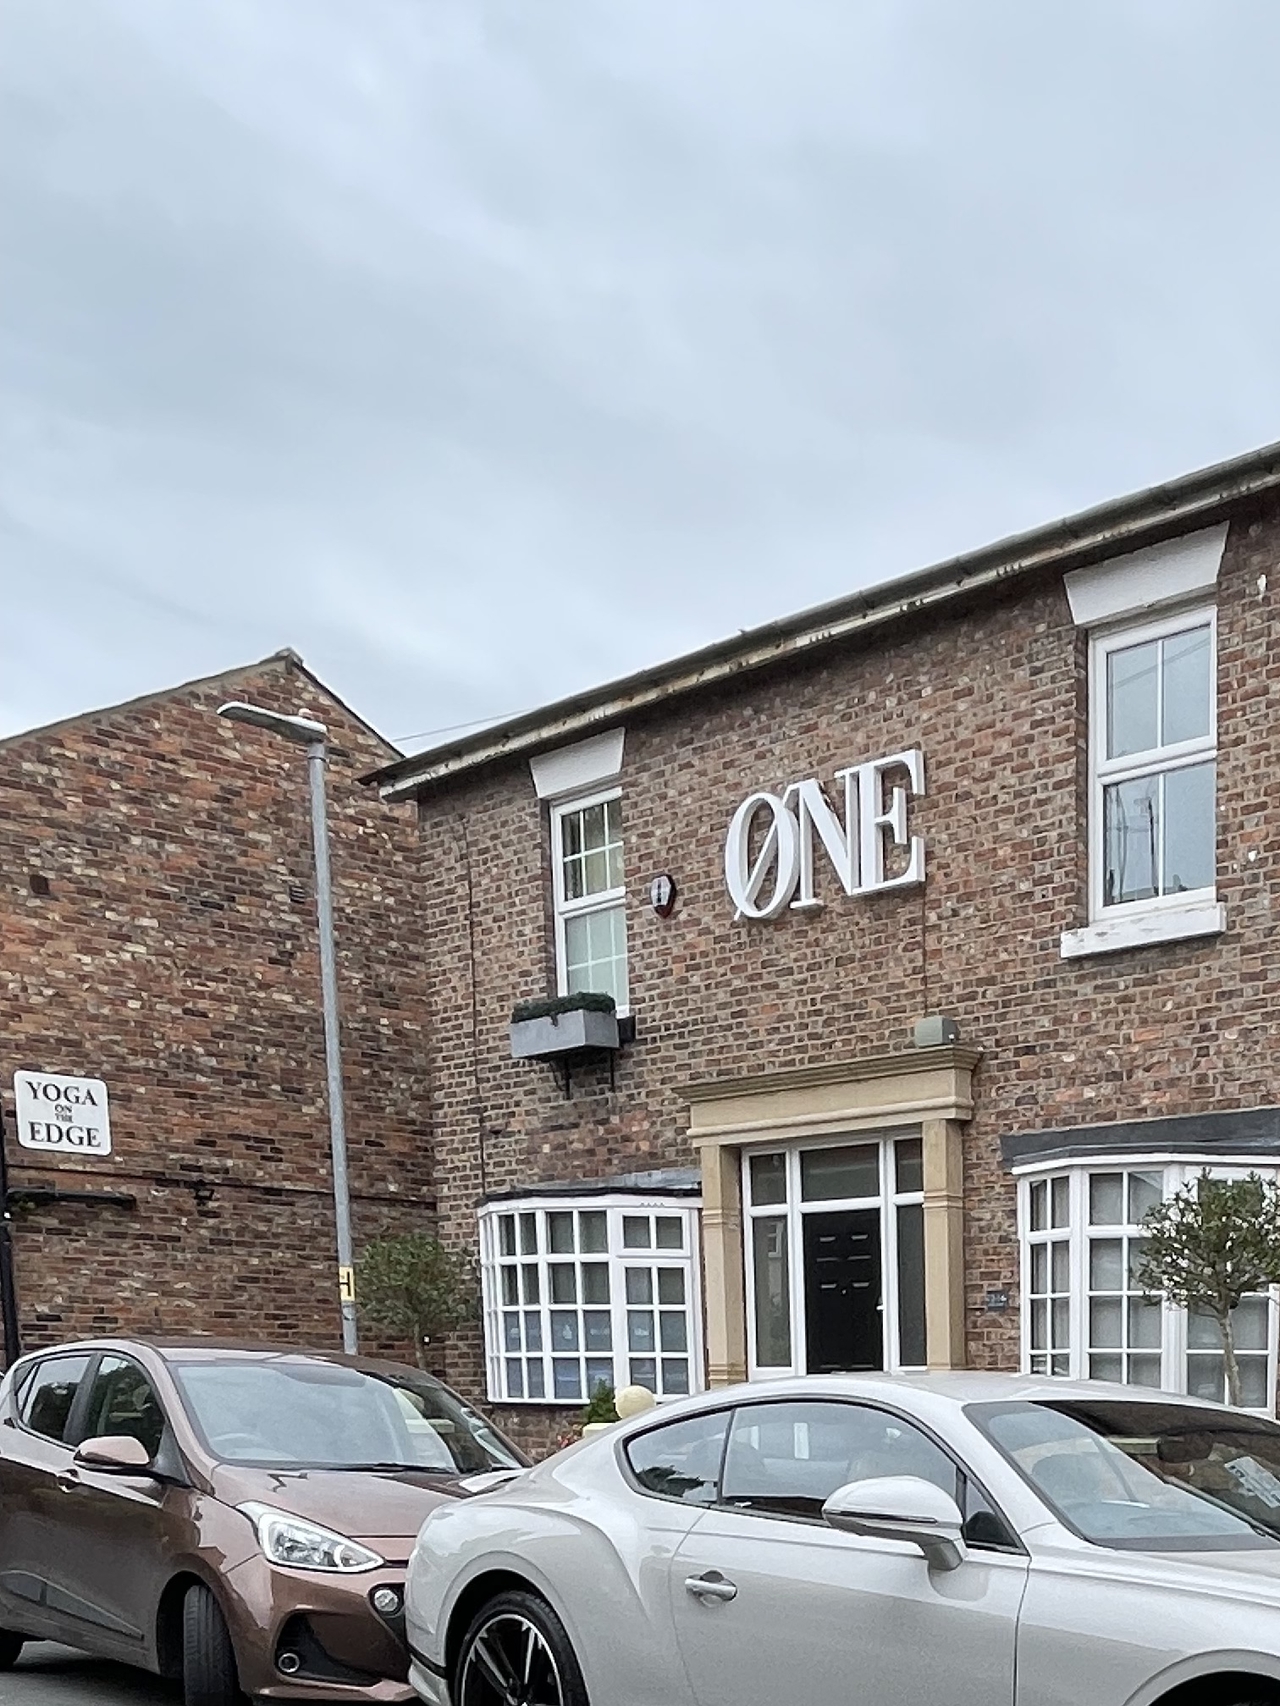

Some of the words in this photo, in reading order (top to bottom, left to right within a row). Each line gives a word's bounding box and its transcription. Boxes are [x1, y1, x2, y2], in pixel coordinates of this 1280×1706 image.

[25, 1080, 98, 1106] YOGA
[54, 1104, 73, 1113] ON
[54, 1113, 74, 1123] THE
[28, 1121, 101, 1147] EDGE
